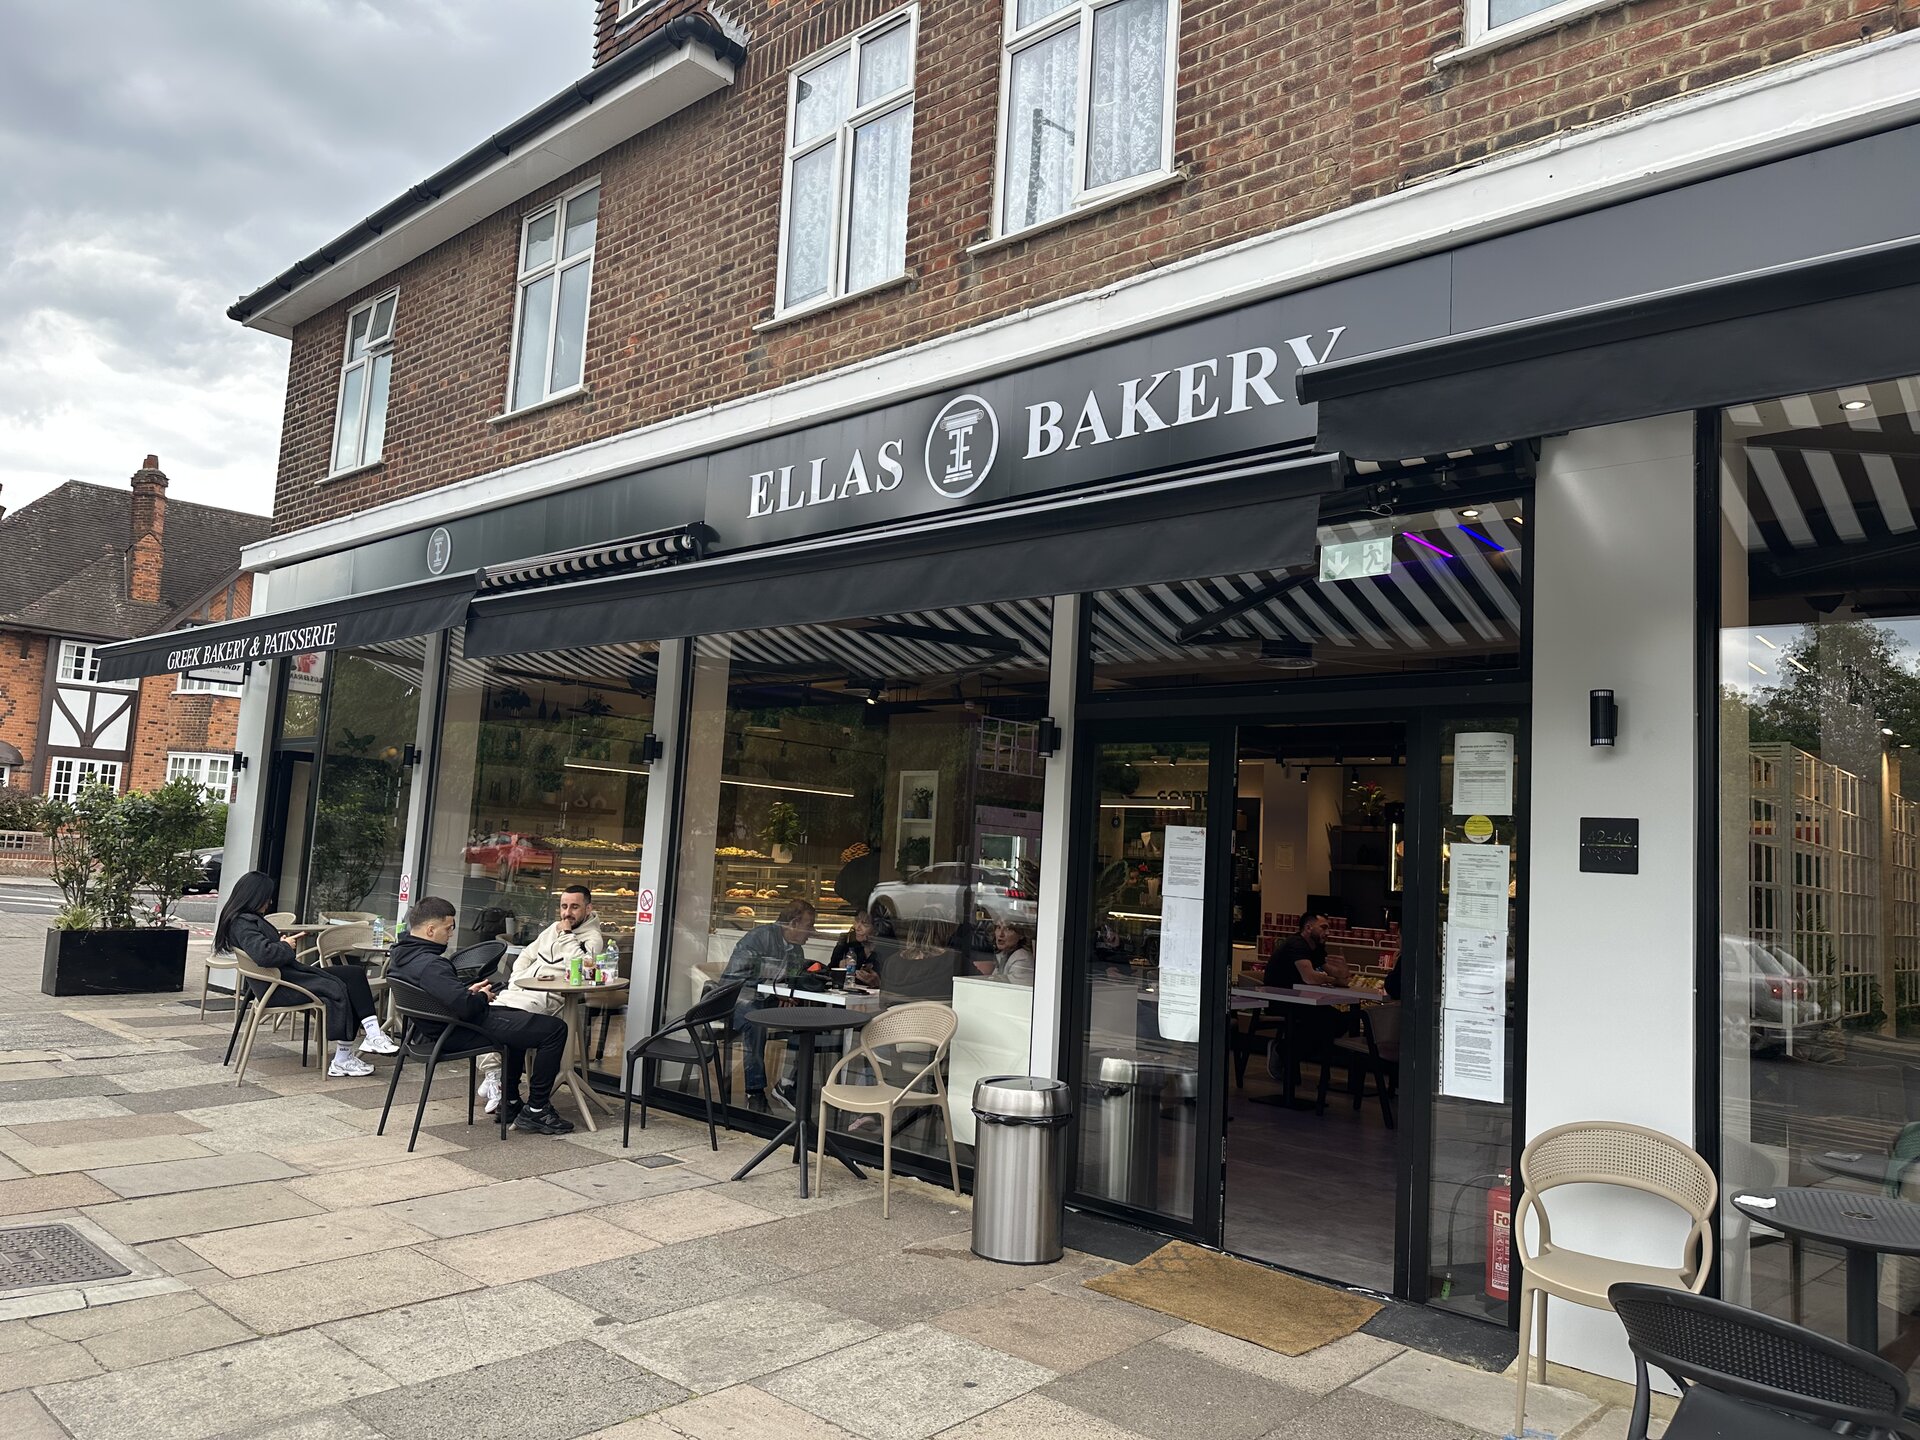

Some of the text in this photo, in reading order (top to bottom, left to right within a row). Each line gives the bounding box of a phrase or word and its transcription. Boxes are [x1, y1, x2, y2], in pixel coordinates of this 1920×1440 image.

[747, 326, 1347, 518] ELLAS BAKERY
[168, 624, 337, 670] GREEK BAKERY & PATISSERIE
[1588, 830, 1631, 843] 42-46
